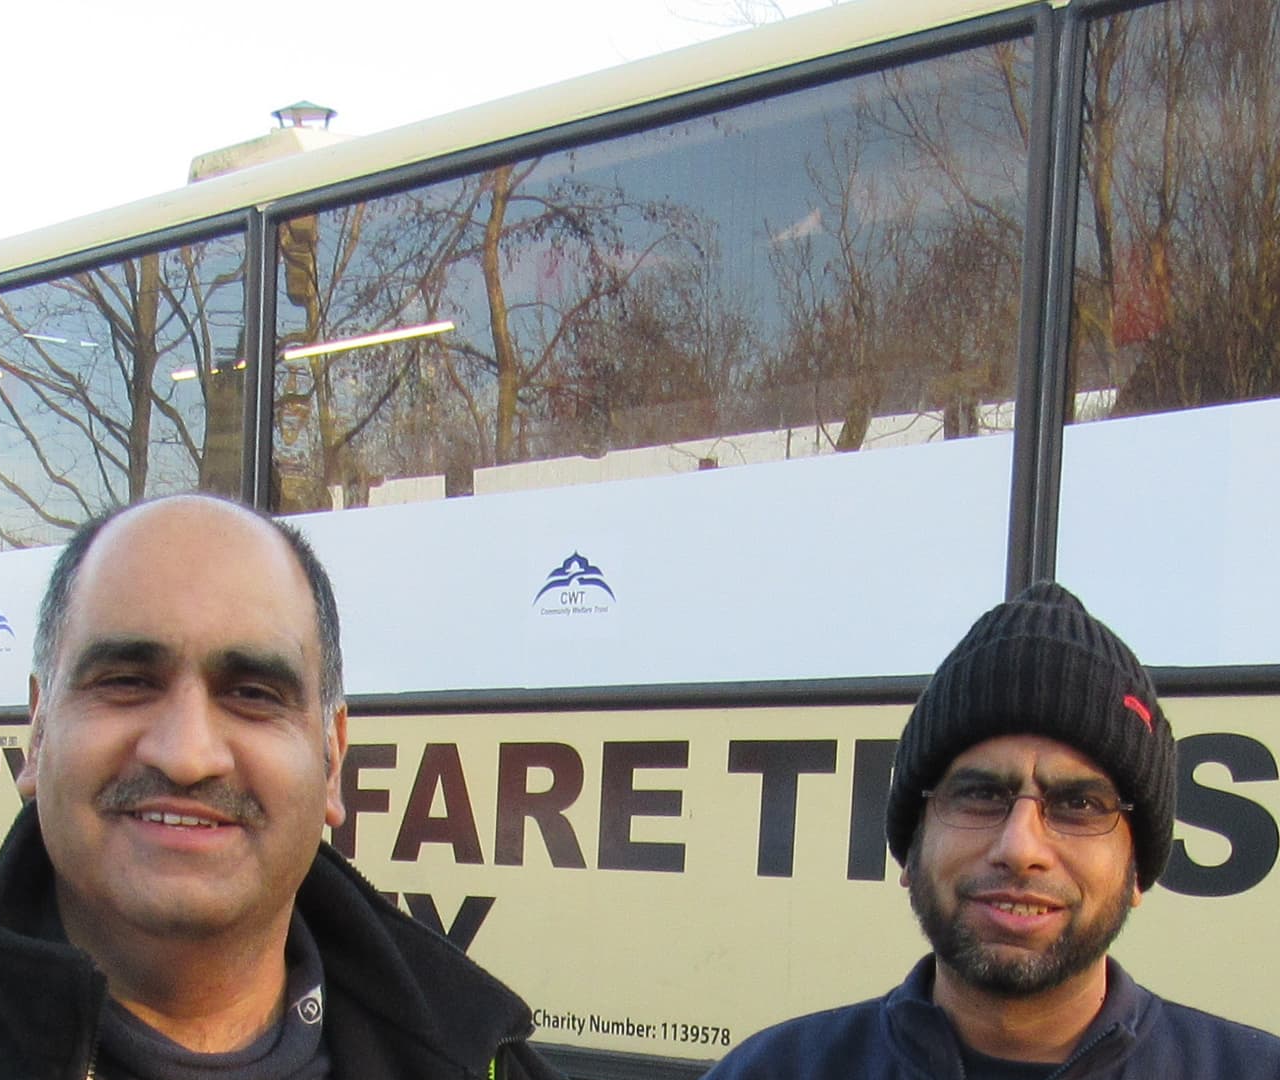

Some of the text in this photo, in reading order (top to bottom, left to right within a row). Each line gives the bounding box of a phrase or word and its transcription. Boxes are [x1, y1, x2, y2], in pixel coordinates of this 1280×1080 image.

[560, 591, 586, 605] CWT
[331, 741, 690, 873] FARE
[532, 1009, 731, 1046] Charity Number: 1139578
